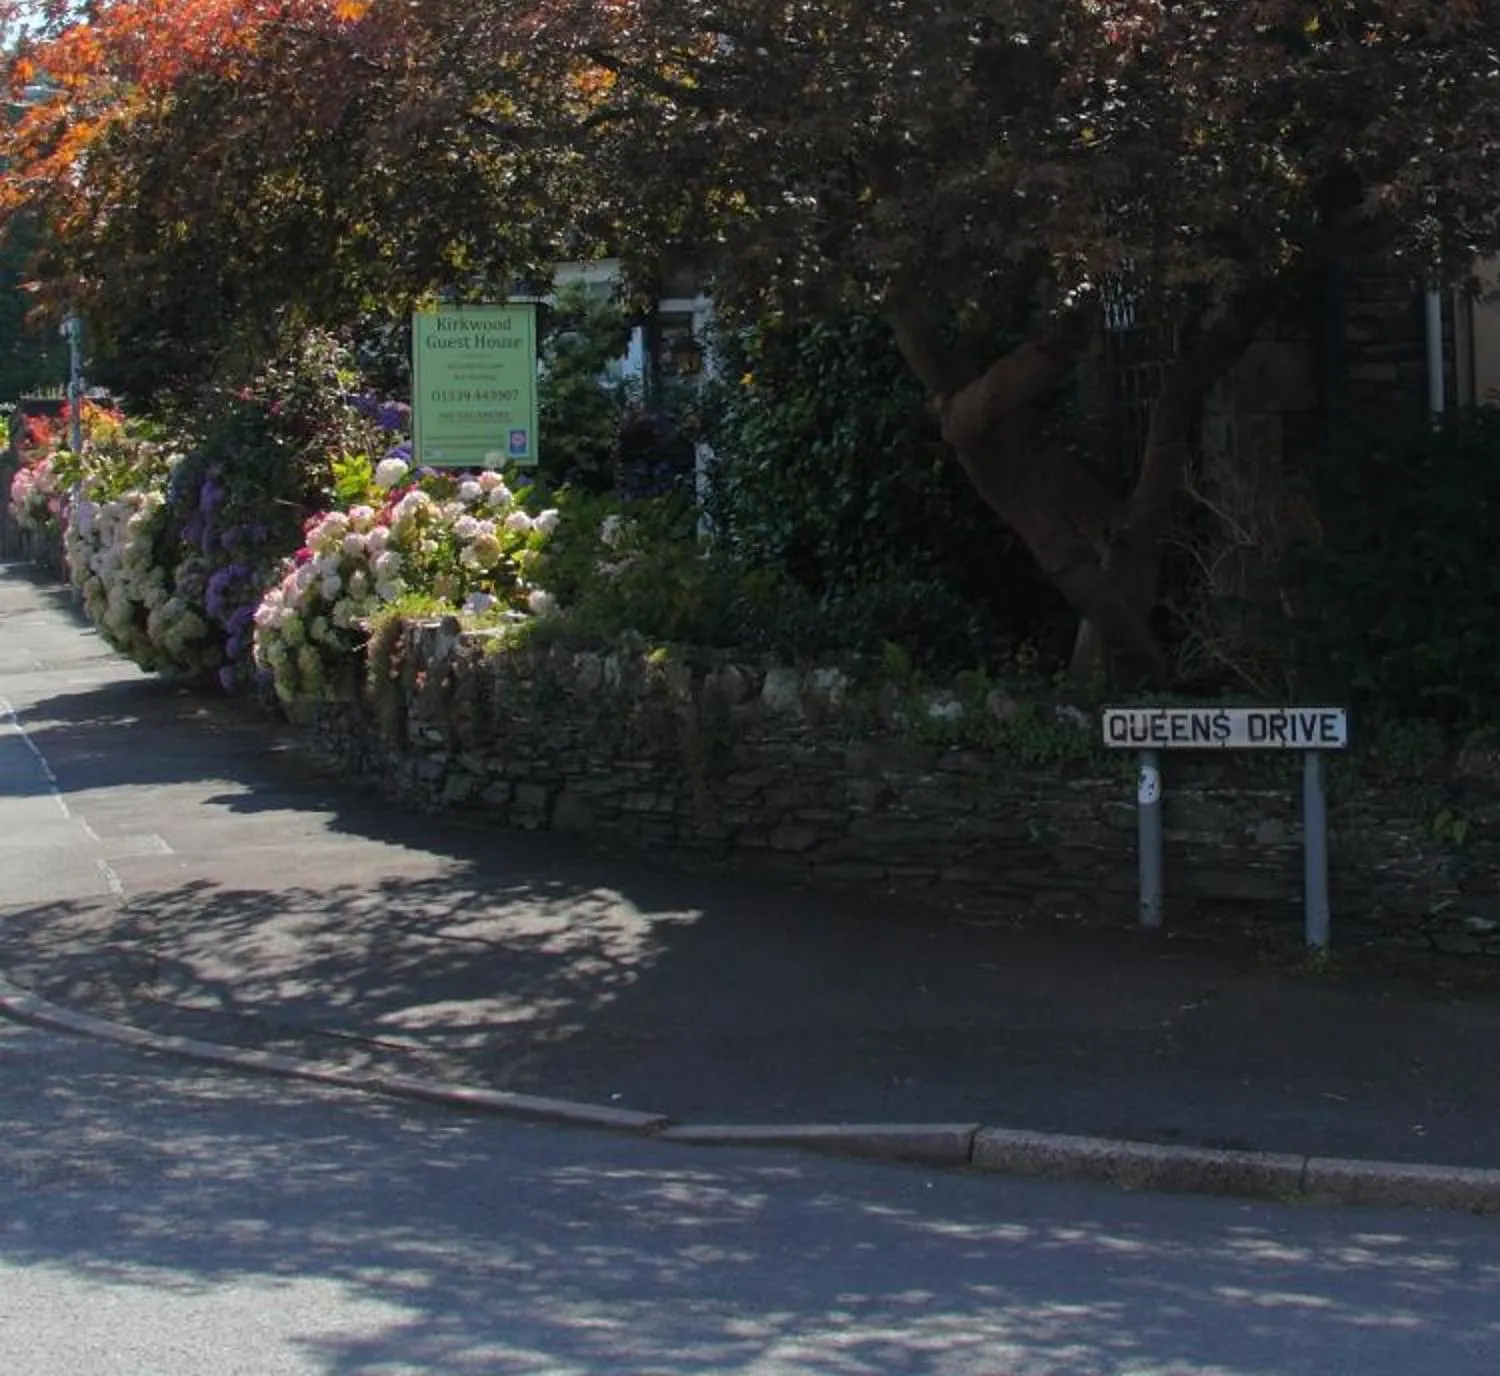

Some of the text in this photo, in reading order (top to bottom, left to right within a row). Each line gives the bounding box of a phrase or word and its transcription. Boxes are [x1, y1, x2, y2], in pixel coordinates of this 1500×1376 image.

[437, 316, 512, 332] Kirkwood
[426, 335, 524, 350] Guest House
[1109, 713, 1339, 742] QUEENS DRIVE
